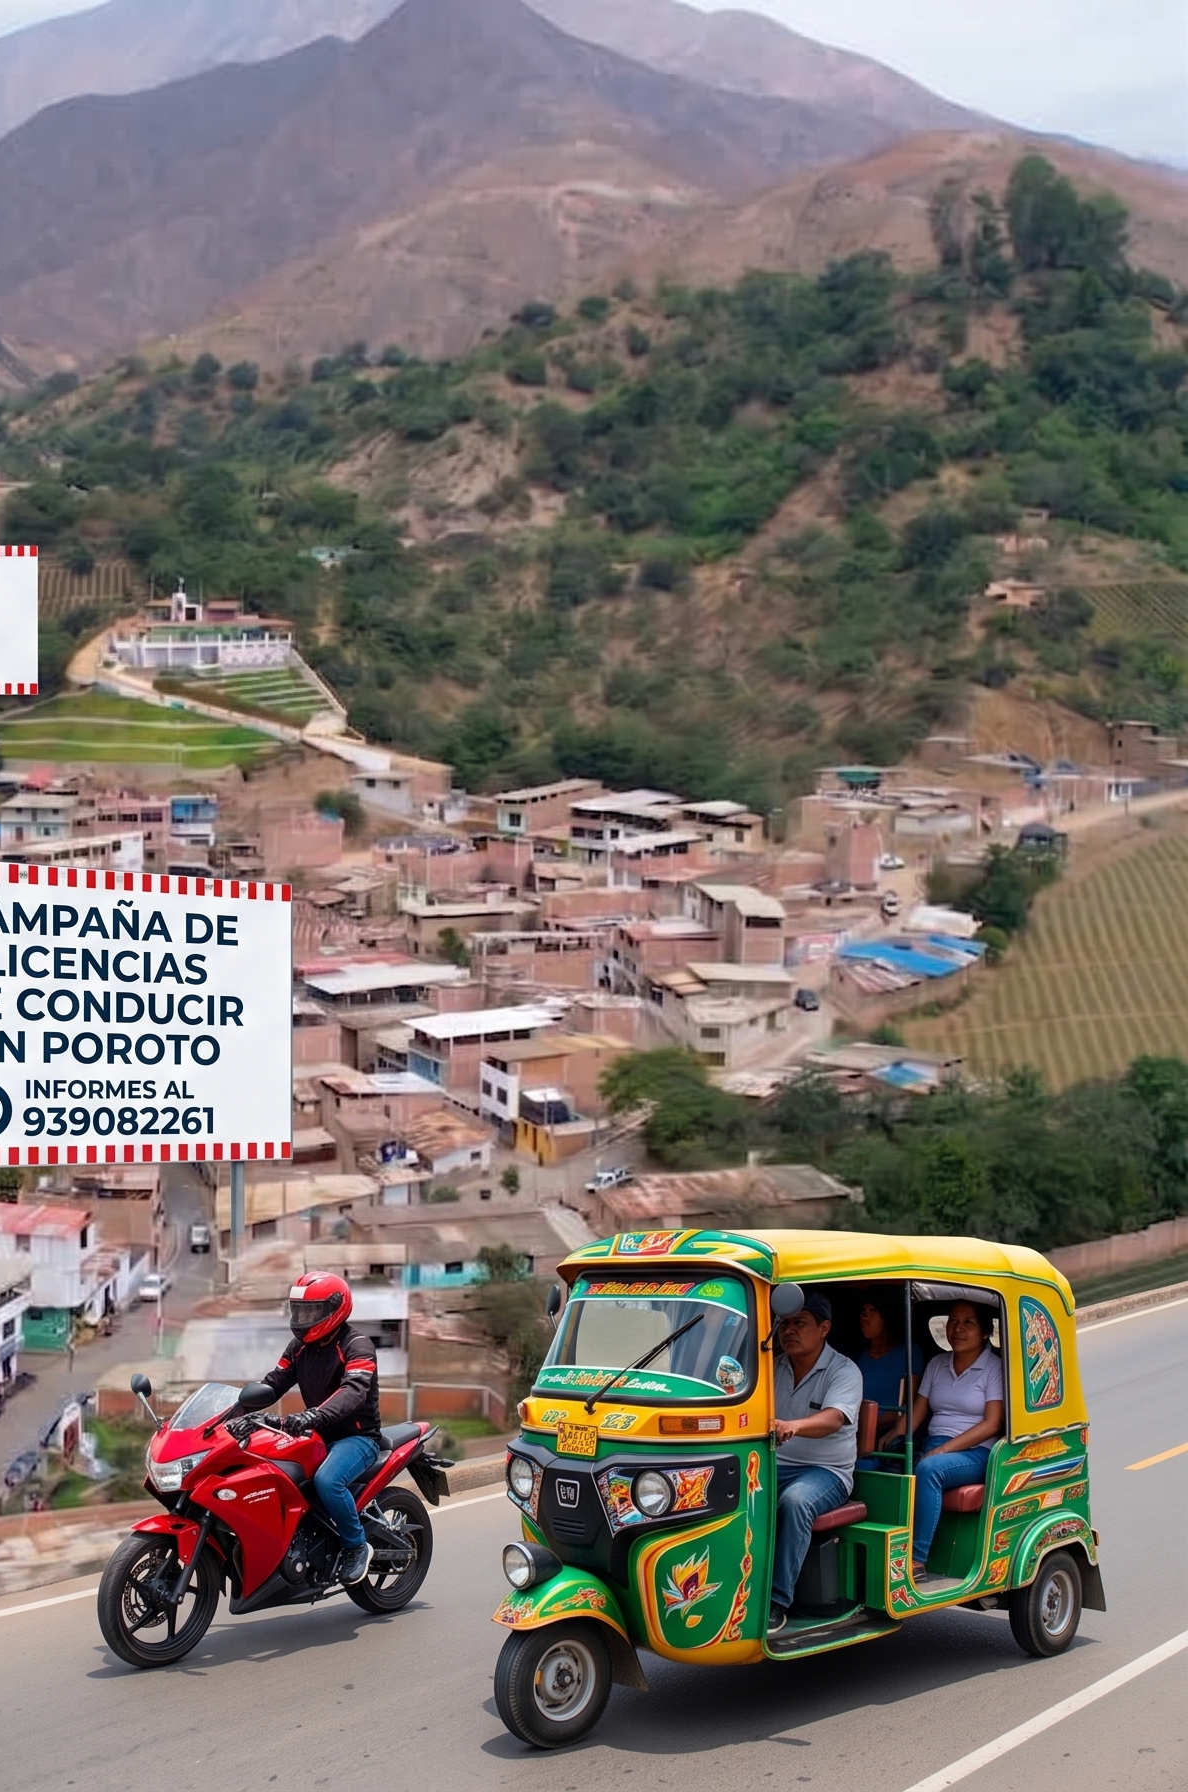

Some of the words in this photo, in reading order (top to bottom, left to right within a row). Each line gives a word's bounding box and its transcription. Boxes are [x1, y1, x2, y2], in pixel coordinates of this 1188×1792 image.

[185, 912, 239, 947] DE
[16, 987, 244, 1027] CONDUCIR
[43, 1031, 221, 1066] POROTO
[25, 1079, 157, 1100] INFORMES
[163, 1080, 195, 1100] AL
[22, 1106, 214, 1137] 939082261
